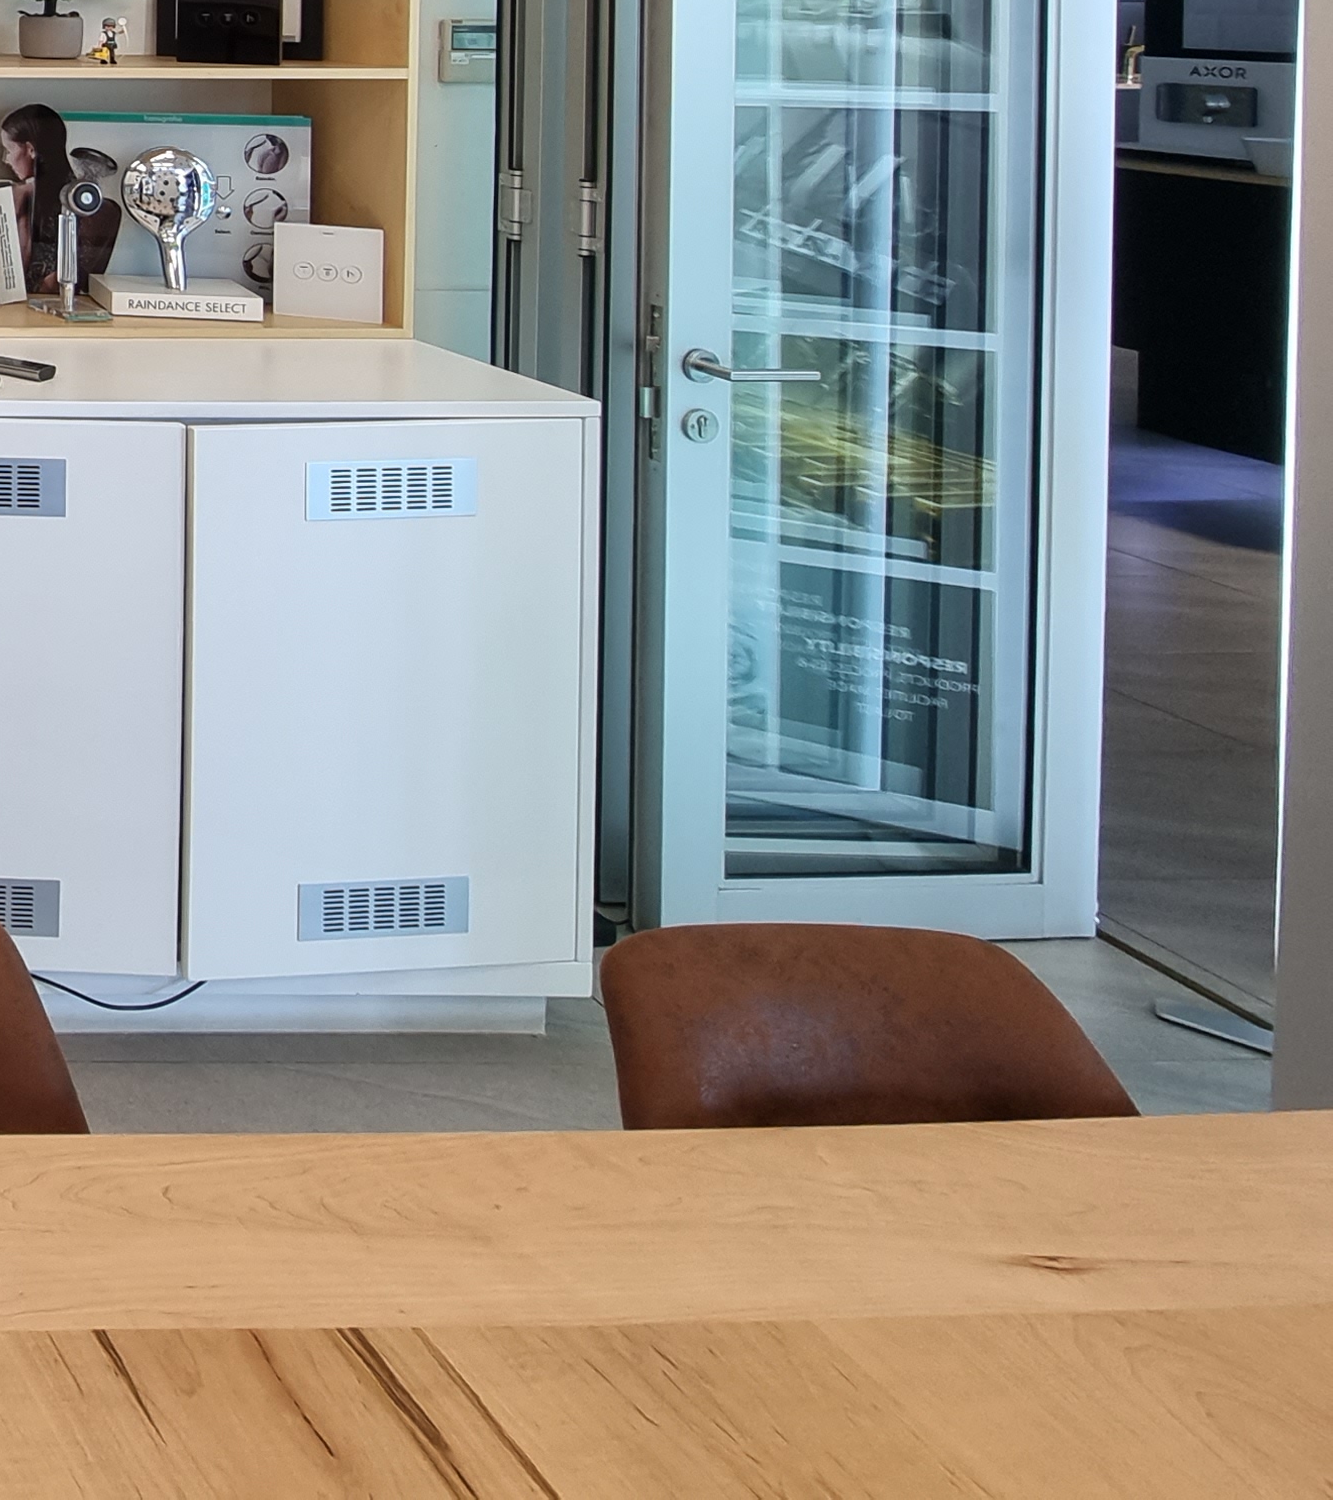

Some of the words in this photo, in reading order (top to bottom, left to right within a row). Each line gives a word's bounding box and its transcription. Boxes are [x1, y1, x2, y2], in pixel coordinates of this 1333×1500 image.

[1189, 65, 1248, 80] AXOR
[128, 298, 201, 312] RAINDANCE
[206, 302, 247, 314] SELECT
